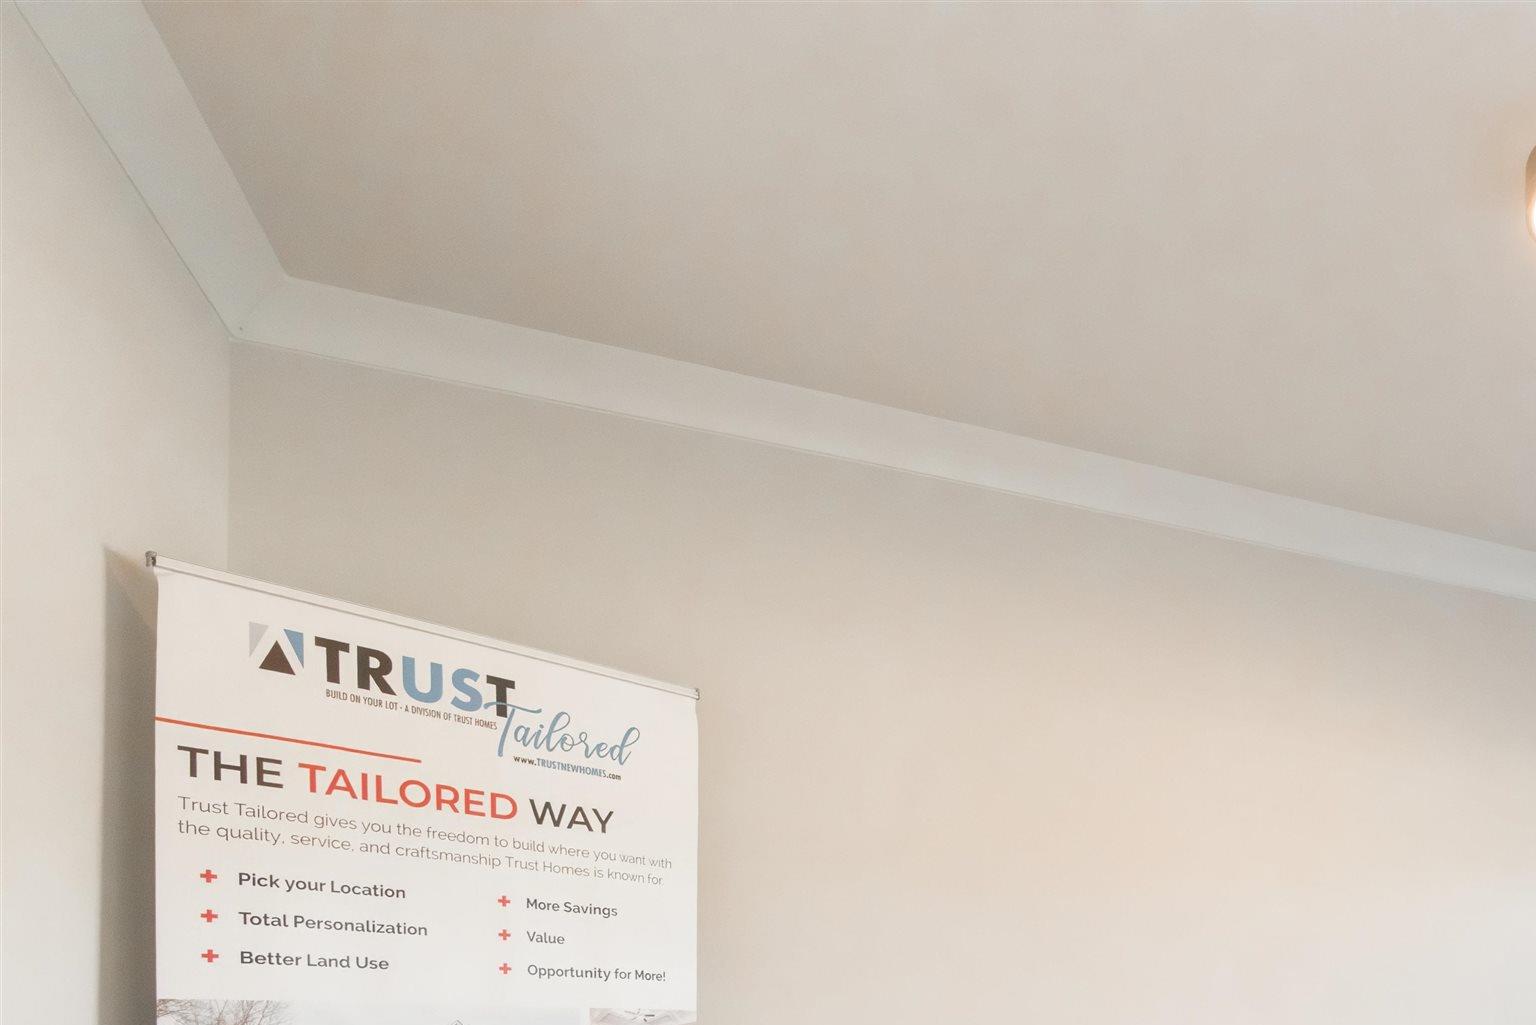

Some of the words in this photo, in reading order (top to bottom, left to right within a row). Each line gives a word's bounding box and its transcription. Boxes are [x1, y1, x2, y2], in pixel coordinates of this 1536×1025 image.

[315, 636, 515, 718] TRUST
[326, 689, 347, 701] BUILD
[350, 694, 361, 703] ON
[363, 696, 383, 708] YOUR
[385, 700, 398, 711] LOT
[411, 706, 441, 719] DIVISION
[443, 712, 452, 721] OF
[454, 714, 473, 726] TRUST
[475, 719, 498, 731] HOMES
[483, 701, 641, 766] Tailored
[513, 755, 622, 781] www.TRUSTNEWHOMES.com
[177, 745, 283, 789] THE
[298, 762, 518, 820] TAILORED
[529, 798, 614, 834] WAY
[177, 795, 229, 815] Trust
[234, 802, 309, 824] Tailored
[313, 813, 357, 830] gives
[361, 820, 391, 834] you
[396, 823, 422, 838] the
[426, 826, 490, 846] freedom
[494, 836, 509, 849] to
[512, 837, 545, 853] build
[548, 843, 590, 858] where
[593, 850, 616, 862] you
[619, 853, 646, 866] want
[648, 855, 672, 869] with
[178, 820, 211, 836] the
[359, 842, 391, 856] and
[395, 844, 501, 869] craftsmanship
[505, 856, 540, 872] Trust
[542, 860, 590, 877] Homes
[593, 867, 604, 879] is
[606, 869, 645, 884] known
[238, 872, 281, 888] Pick
[284, 878, 326, 893] your
[330, 880, 406, 899] Location
[526, 898, 560, 912] More
[563, 901, 618, 919] Savings
[238, 911, 289, 928] Total
[293, 915, 428, 936] Personalization
[526, 930, 565, 945] Value
[240, 950, 302, 966] Better
[306, 953, 351, 969] Land
[355, 957, 390, 970] Use
[527, 964, 611, 982] Opportunity
[614, 968, 632, 980] for
[634, 969, 666, 982] More!
